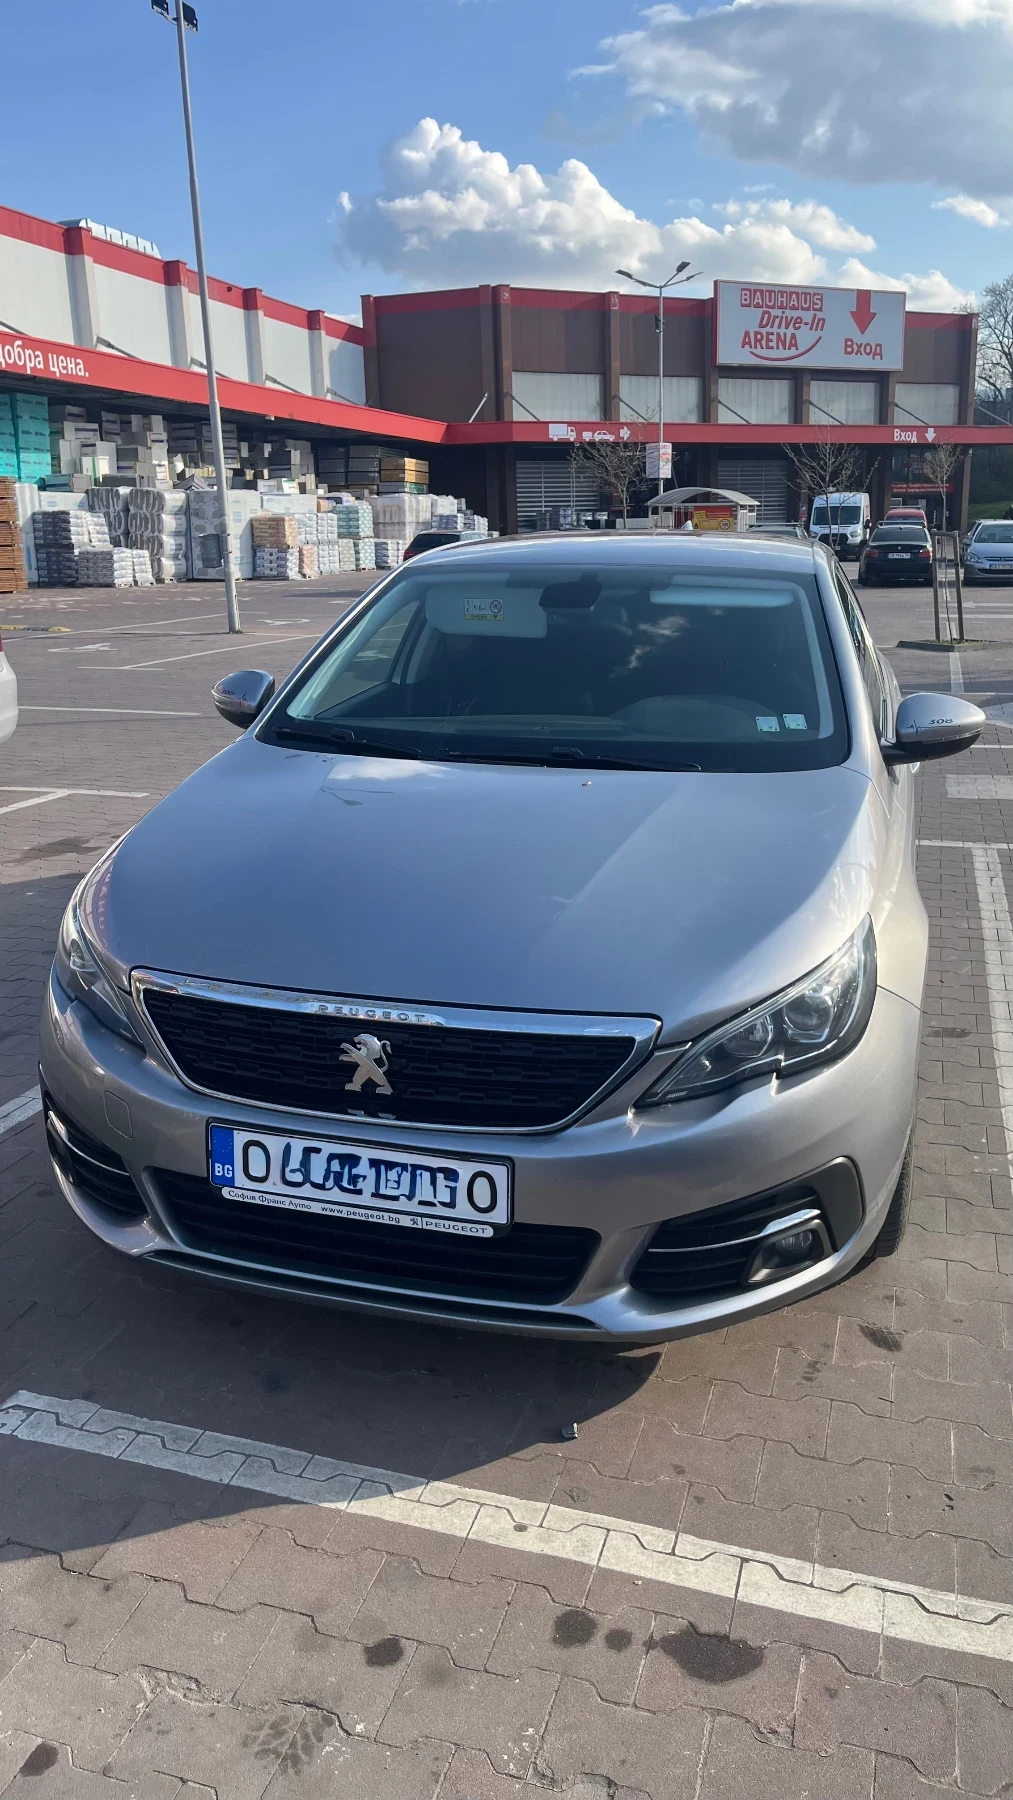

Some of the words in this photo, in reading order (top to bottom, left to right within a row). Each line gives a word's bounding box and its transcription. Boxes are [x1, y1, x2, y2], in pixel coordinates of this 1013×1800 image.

[741, 288, 823, 311] BAUHAUS
[758, 310, 826, 331] Drive-In
[741, 330, 799, 350] ARENA
[844, 338, 883, 360] Вход
[48, 353, 89, 377] цена.
[894, 429, 917, 443] Вход
[318, 1005, 425, 1022] PEUGEOT
[214, 1162, 233, 1178] BG
[258, 1195, 286, 1205] Франс
[320, 1206, 400, 1224] www.peugeot.bg
[425, 1220, 488, 1234] PEUGEOT
